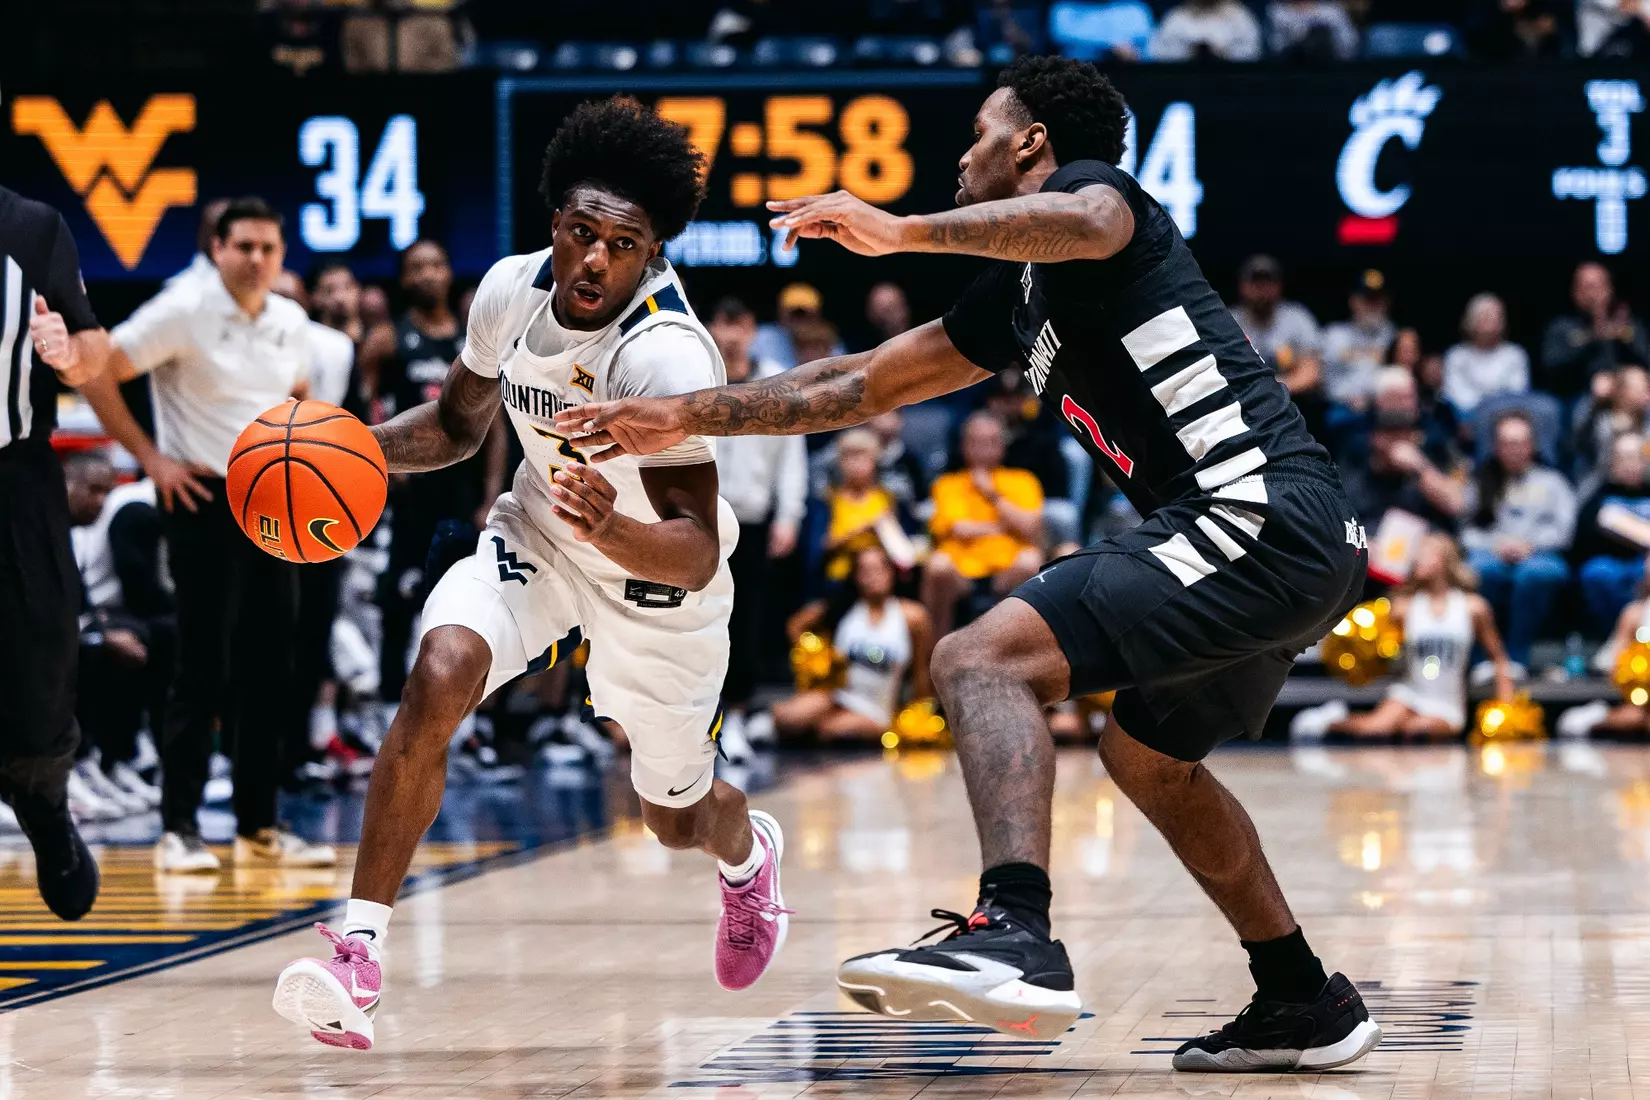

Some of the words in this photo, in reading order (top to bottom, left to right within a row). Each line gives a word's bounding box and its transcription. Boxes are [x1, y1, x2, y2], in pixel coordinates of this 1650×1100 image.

[299, 114, 425, 252] 34
[654, 95, 915, 207] 7:58
[1116, 102, 1204, 239] 4
[1061, 393, 1134, 479] 2
